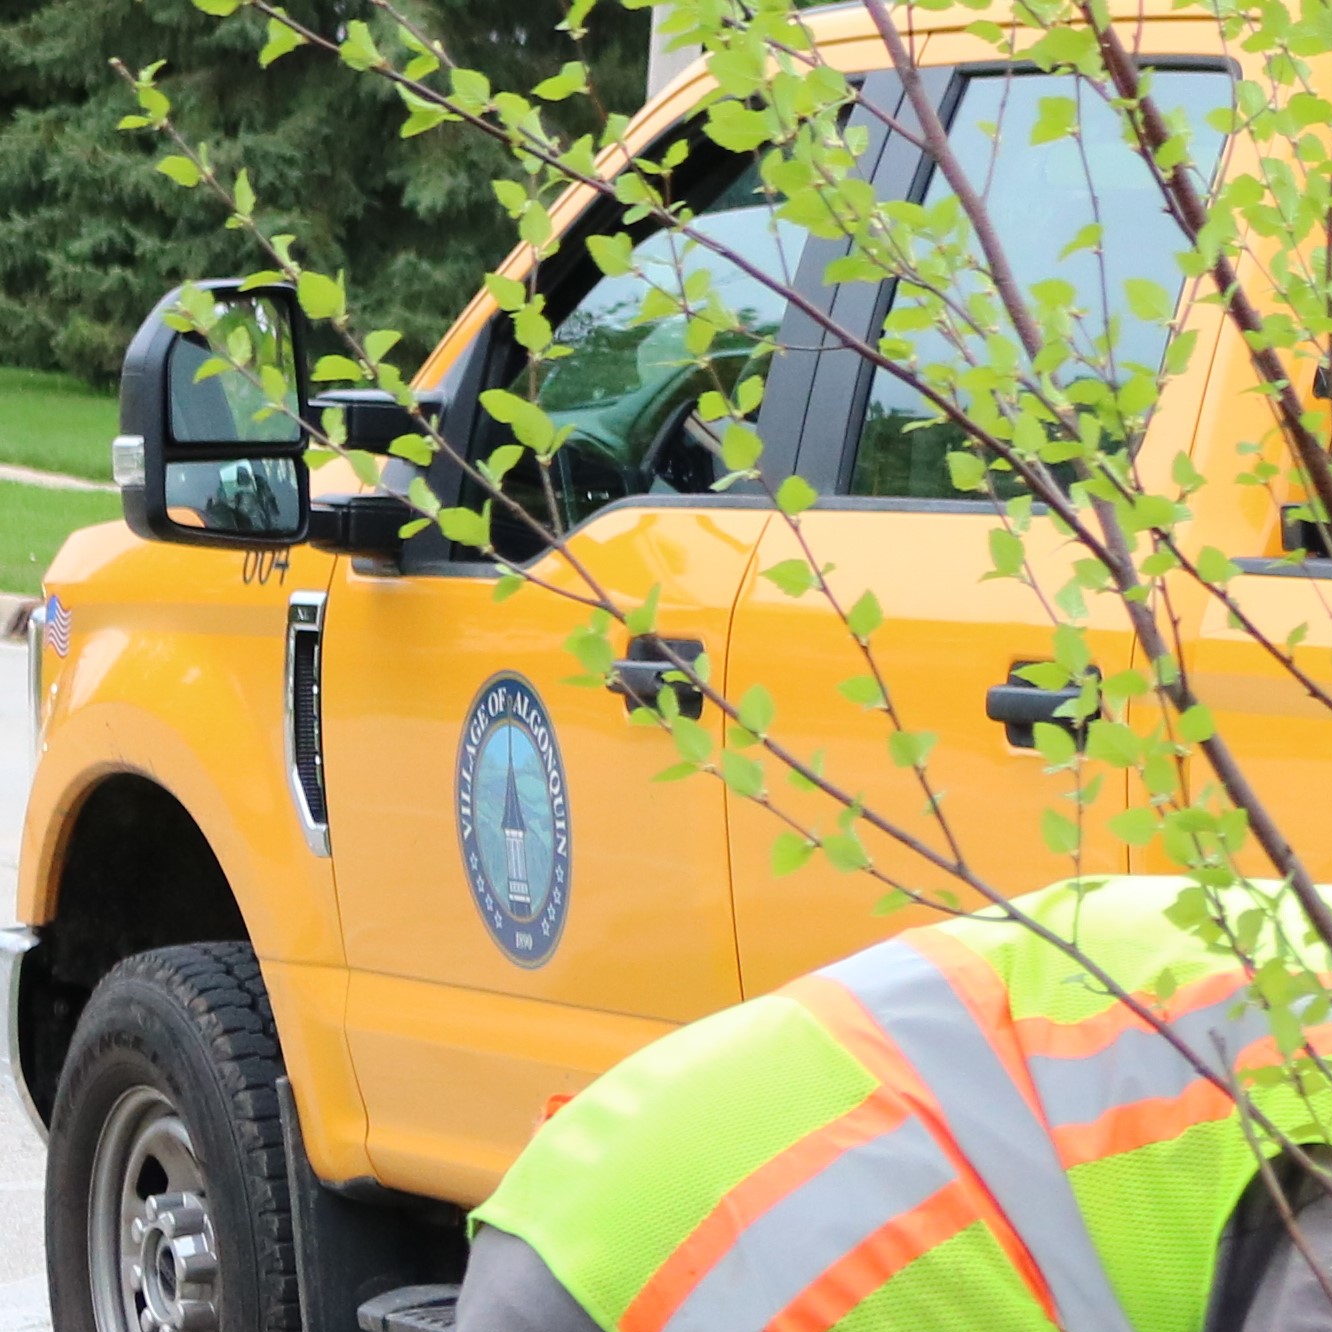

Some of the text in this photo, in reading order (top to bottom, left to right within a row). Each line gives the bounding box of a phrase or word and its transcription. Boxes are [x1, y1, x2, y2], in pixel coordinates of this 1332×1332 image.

[460, 687, 567, 857] VILLAGE OF ALGONQUIN
